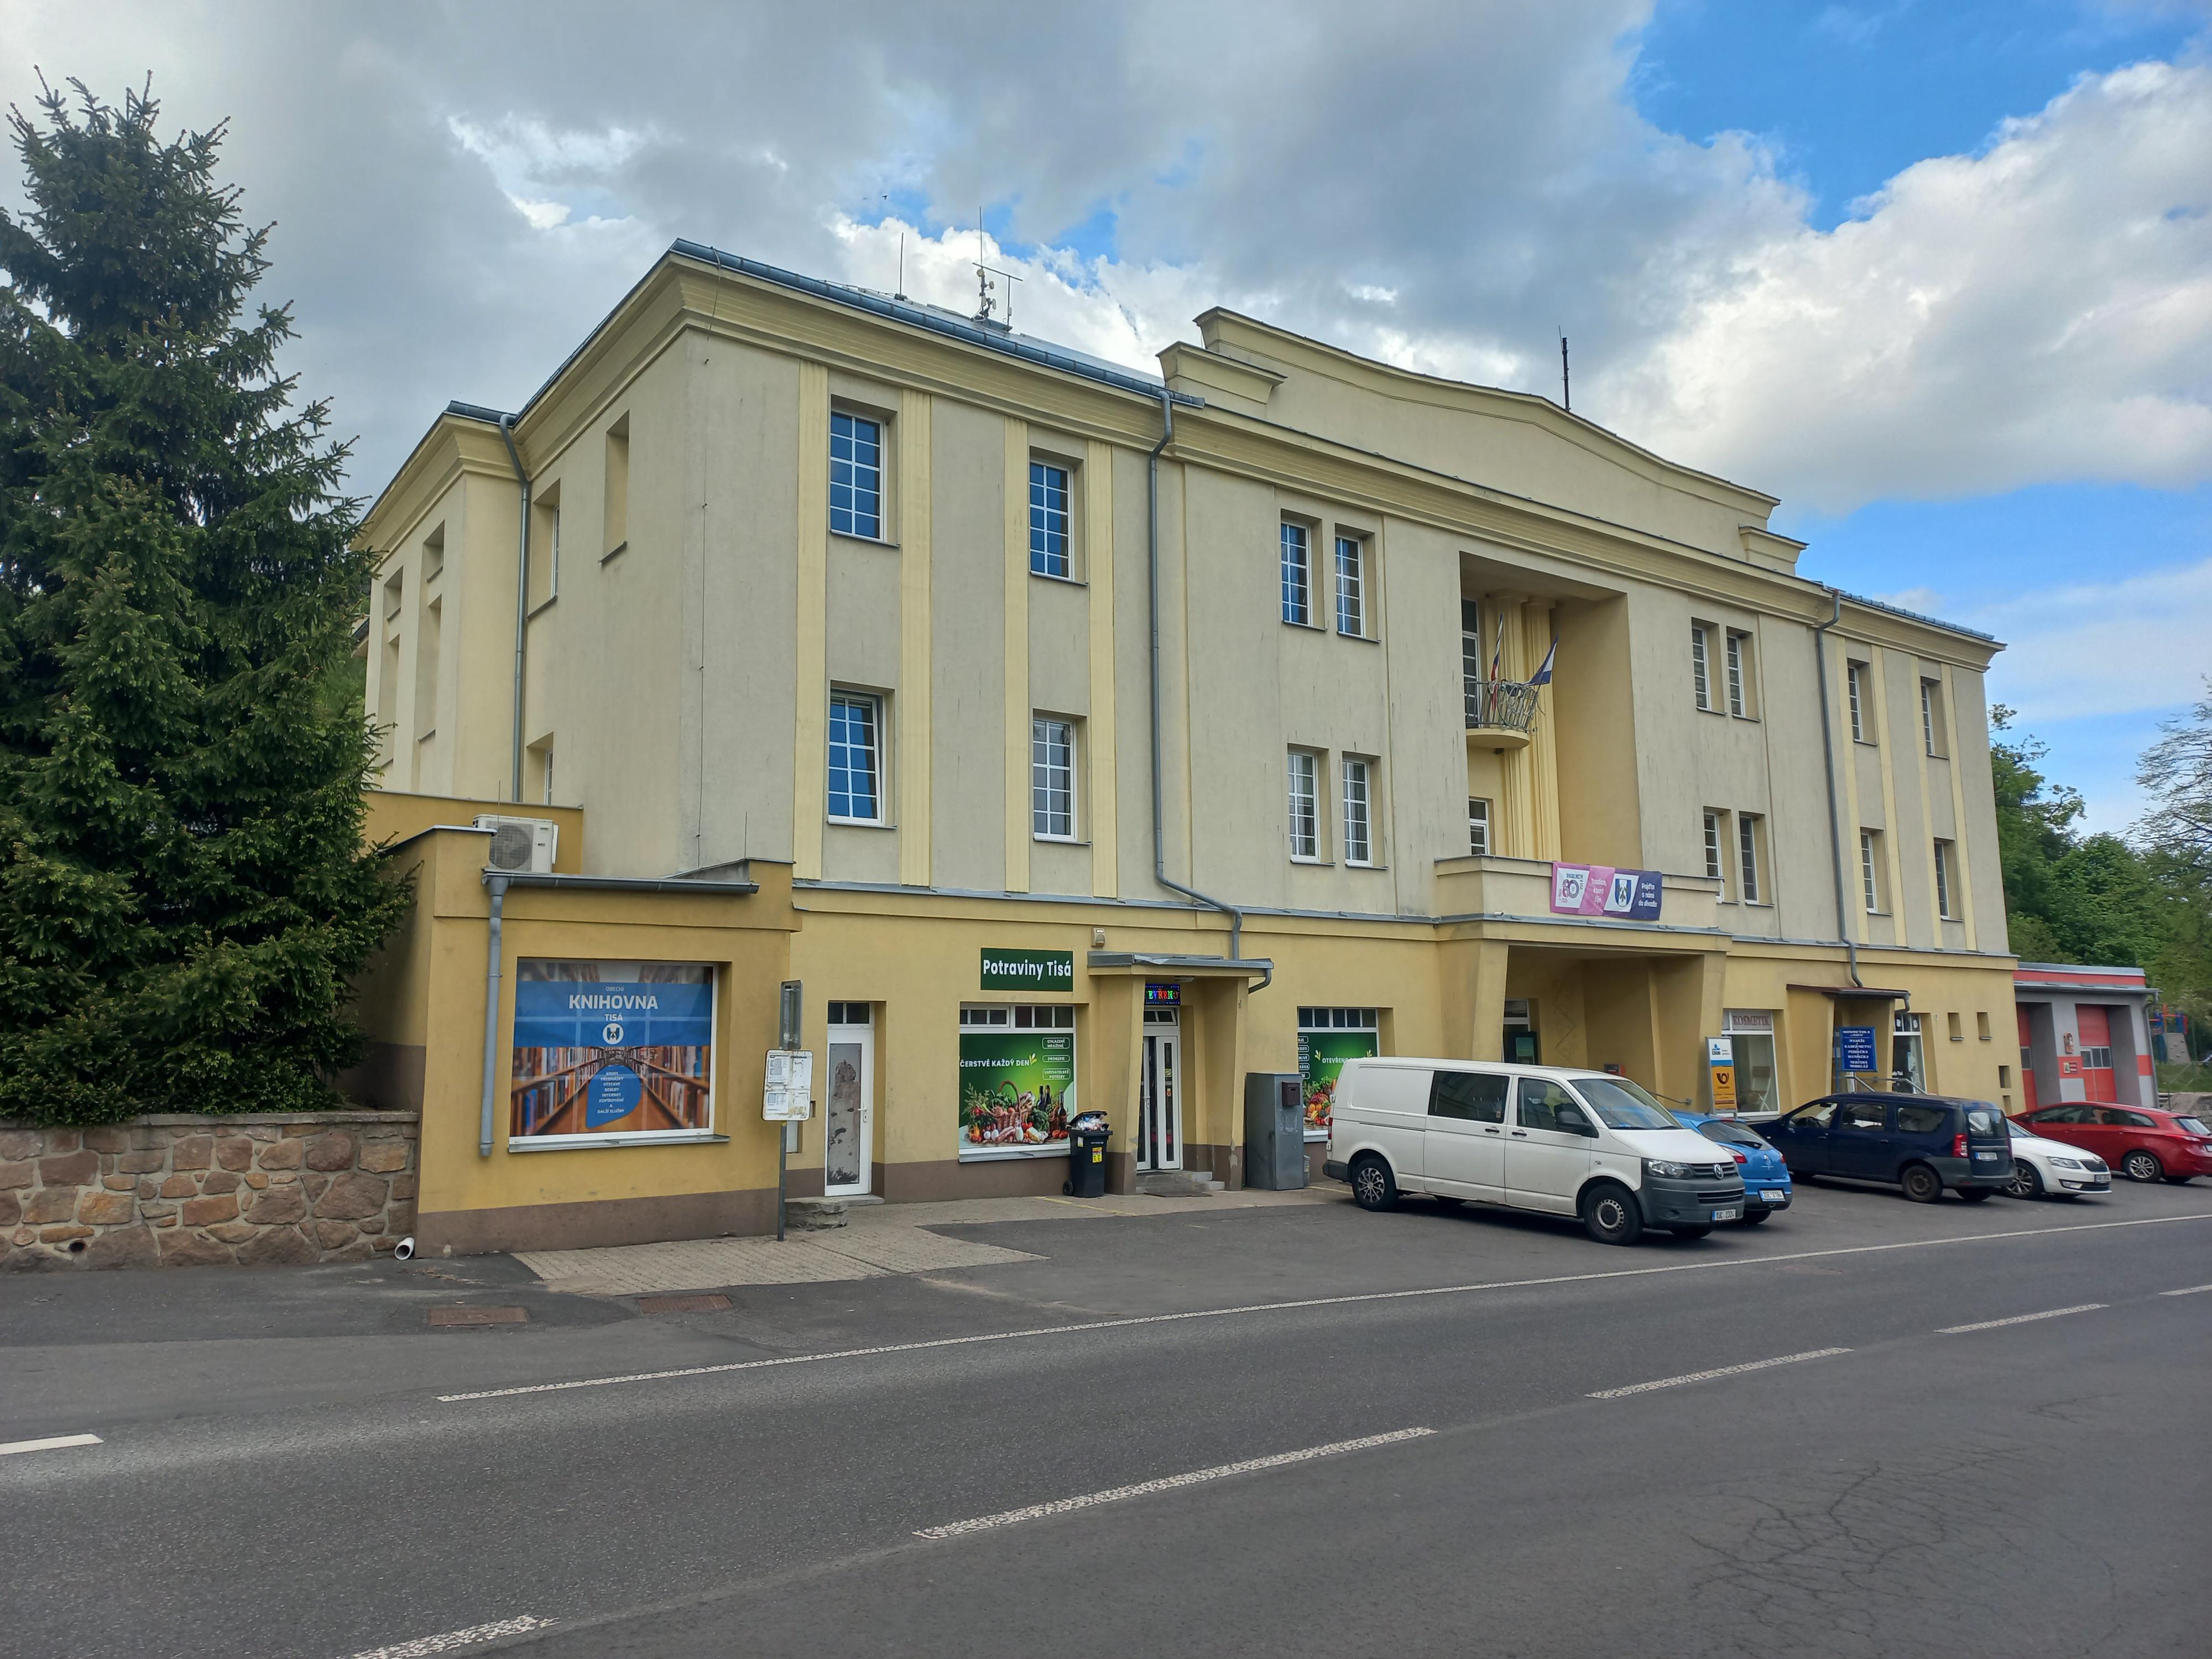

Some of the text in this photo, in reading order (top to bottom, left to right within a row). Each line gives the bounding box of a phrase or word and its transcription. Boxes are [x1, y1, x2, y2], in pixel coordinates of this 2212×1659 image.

[983, 958, 1072, 981] Potraviny Tisá
[568, 994, 659, 1010] KNIHOVNA
[604, 1012, 623, 1022] TISÁ
[959, 1058, 990, 1067] ČERSTVÉ
[992, 1058, 1014, 1067] KAŽDÝ
